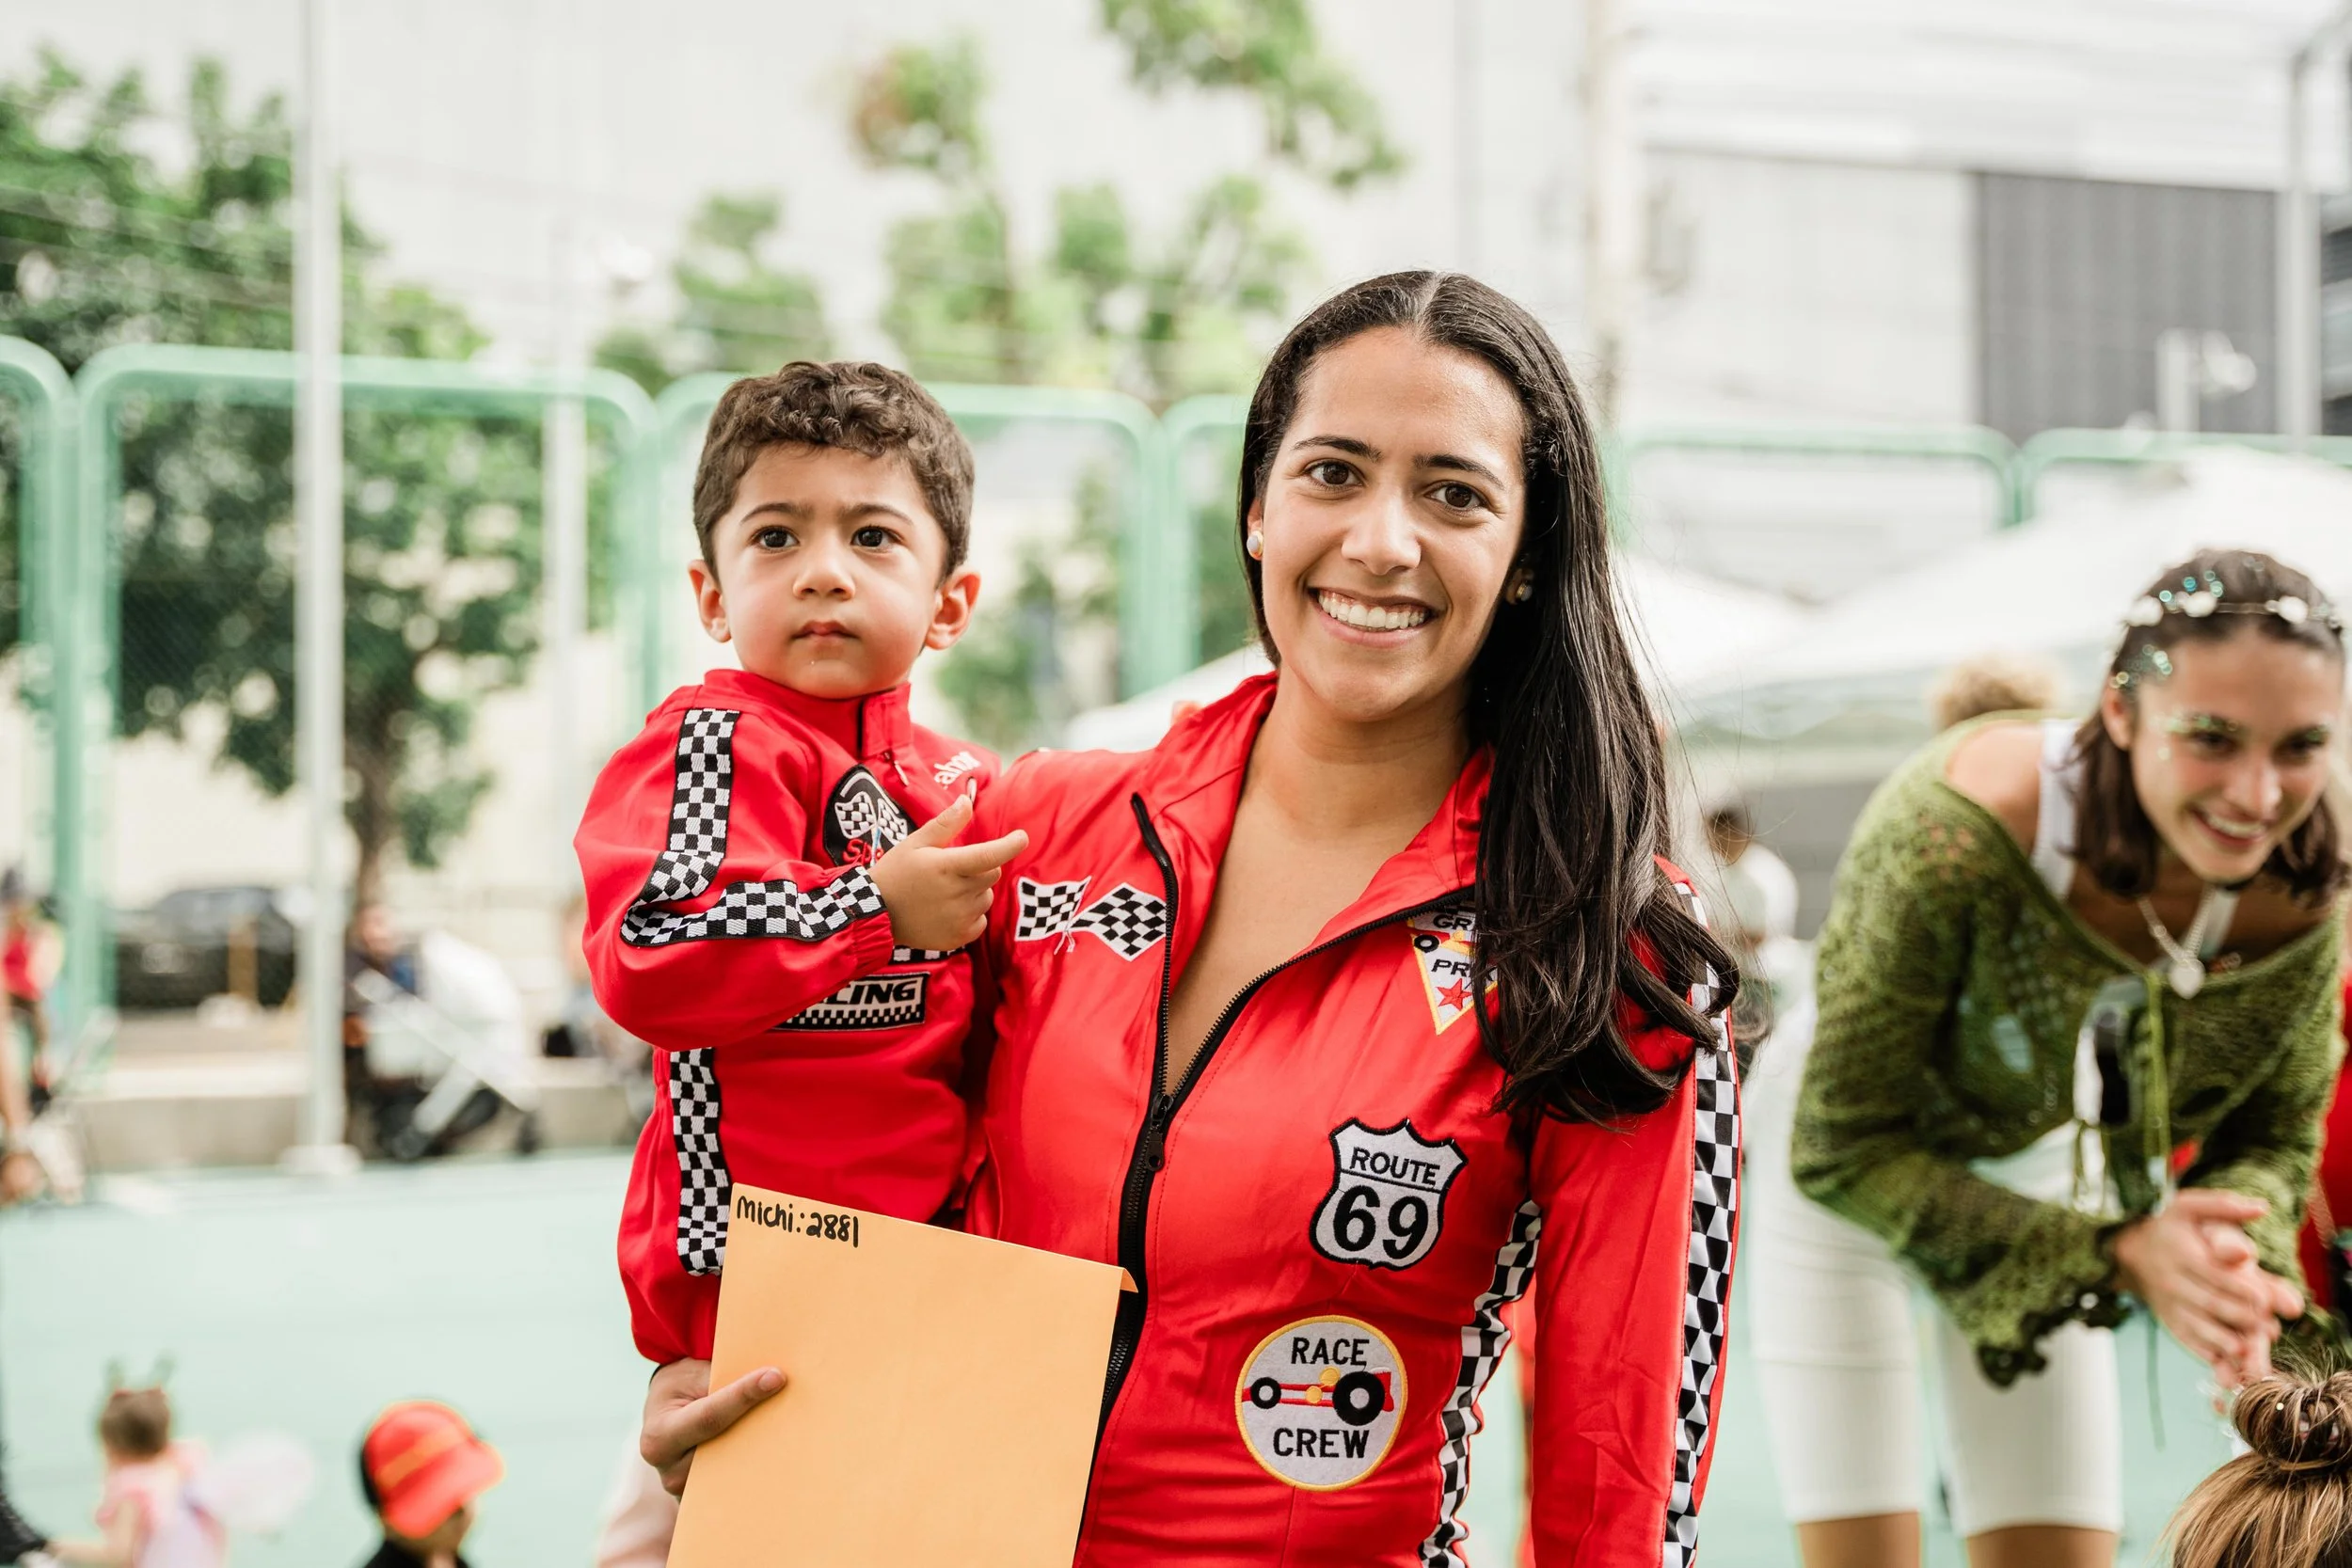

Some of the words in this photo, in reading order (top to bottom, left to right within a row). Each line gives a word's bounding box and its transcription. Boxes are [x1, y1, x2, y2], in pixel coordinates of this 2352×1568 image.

[825, 980, 918, 1006] CING
[1349, 1147, 1441, 1186] ROUTE
[1332, 1184, 1429, 1259] 69
[1291, 1337, 1370, 1367] RACE
[1273, 1427, 1370, 1459] CREW
